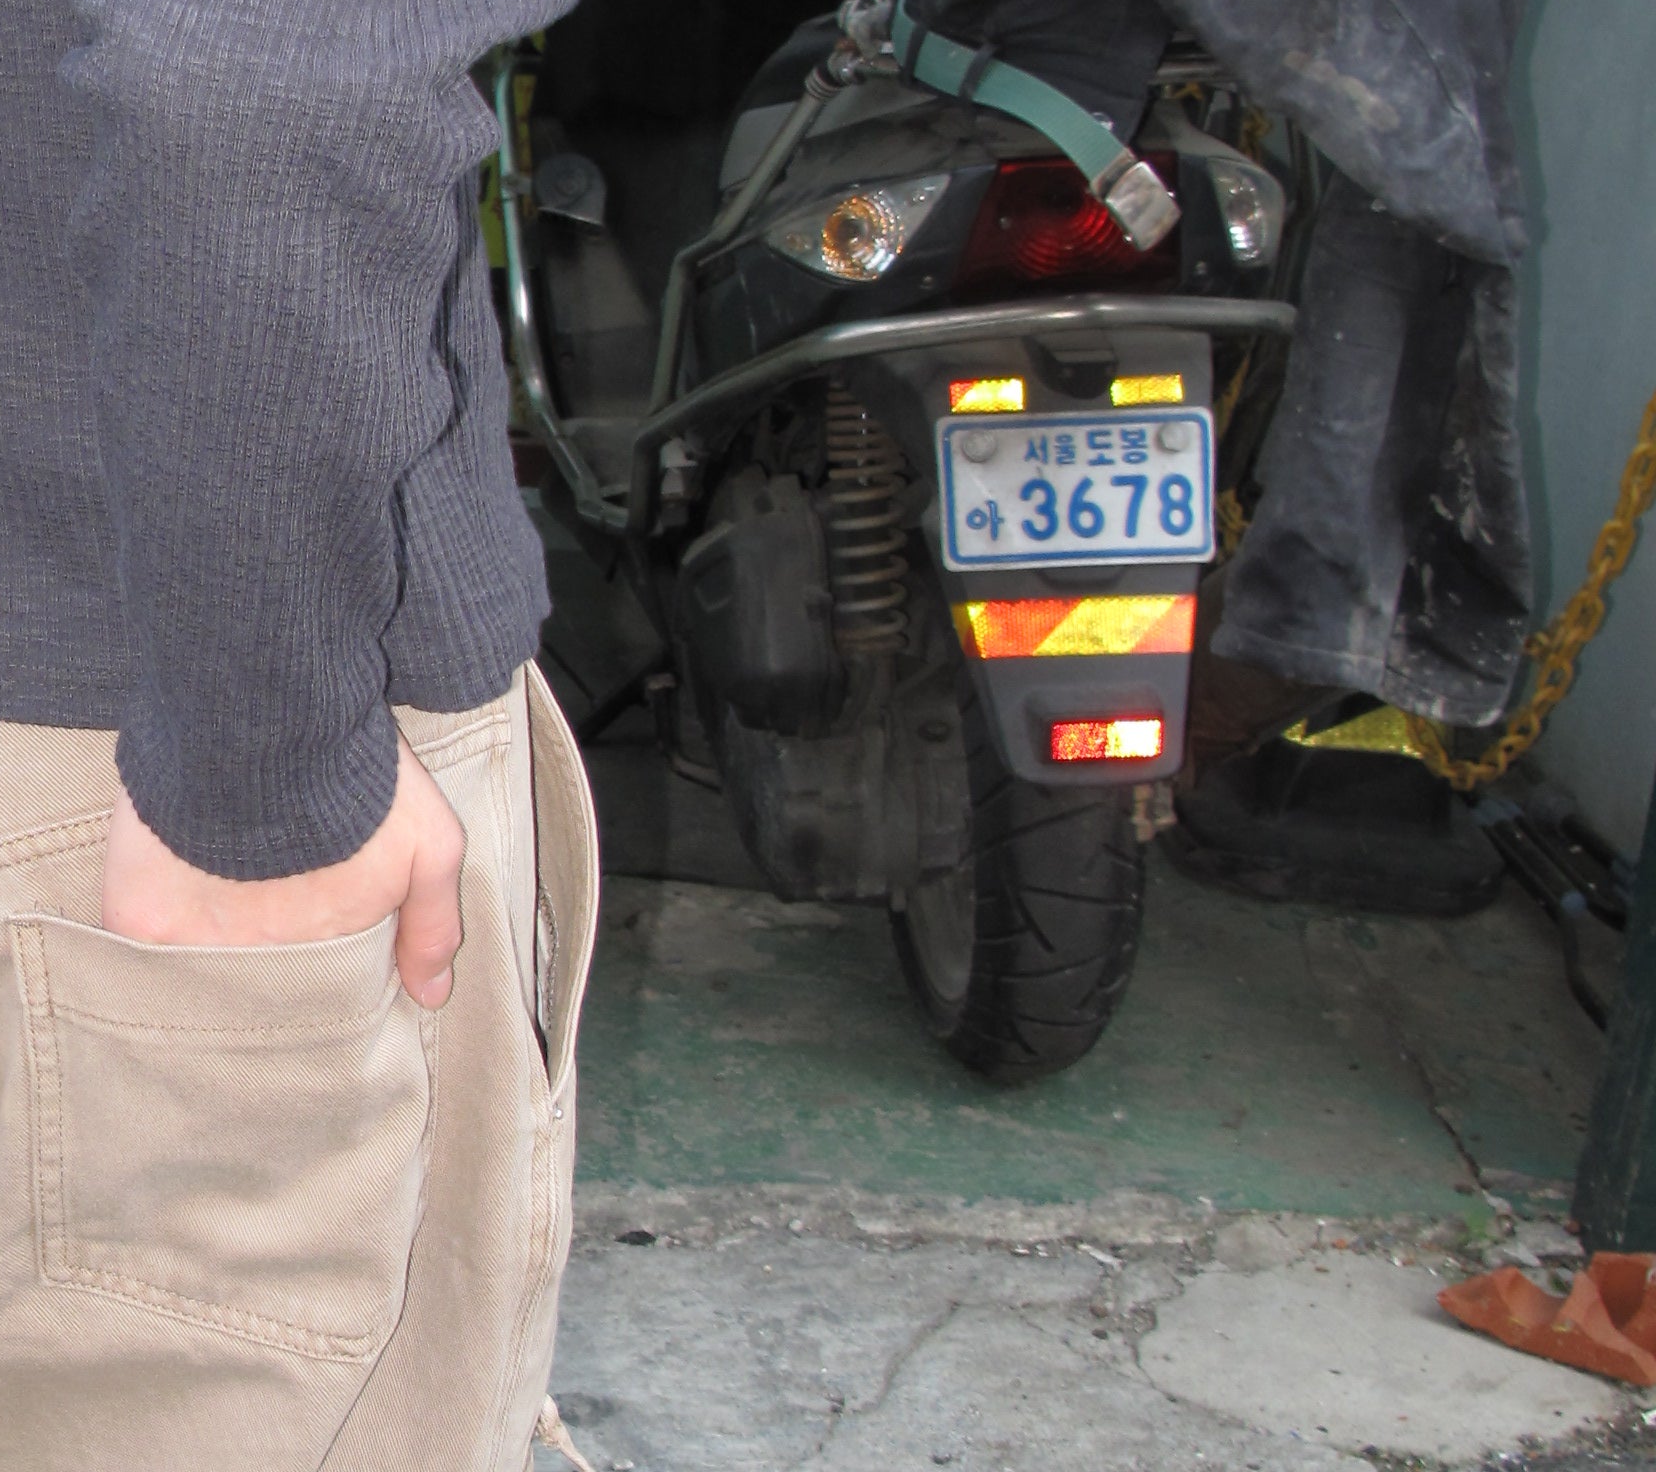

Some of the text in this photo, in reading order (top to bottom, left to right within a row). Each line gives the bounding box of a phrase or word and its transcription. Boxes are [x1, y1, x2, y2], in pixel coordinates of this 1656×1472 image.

[1024, 427, 1149, 468] 서울 도봉
[966, 473, 1195, 542] 아 3678
